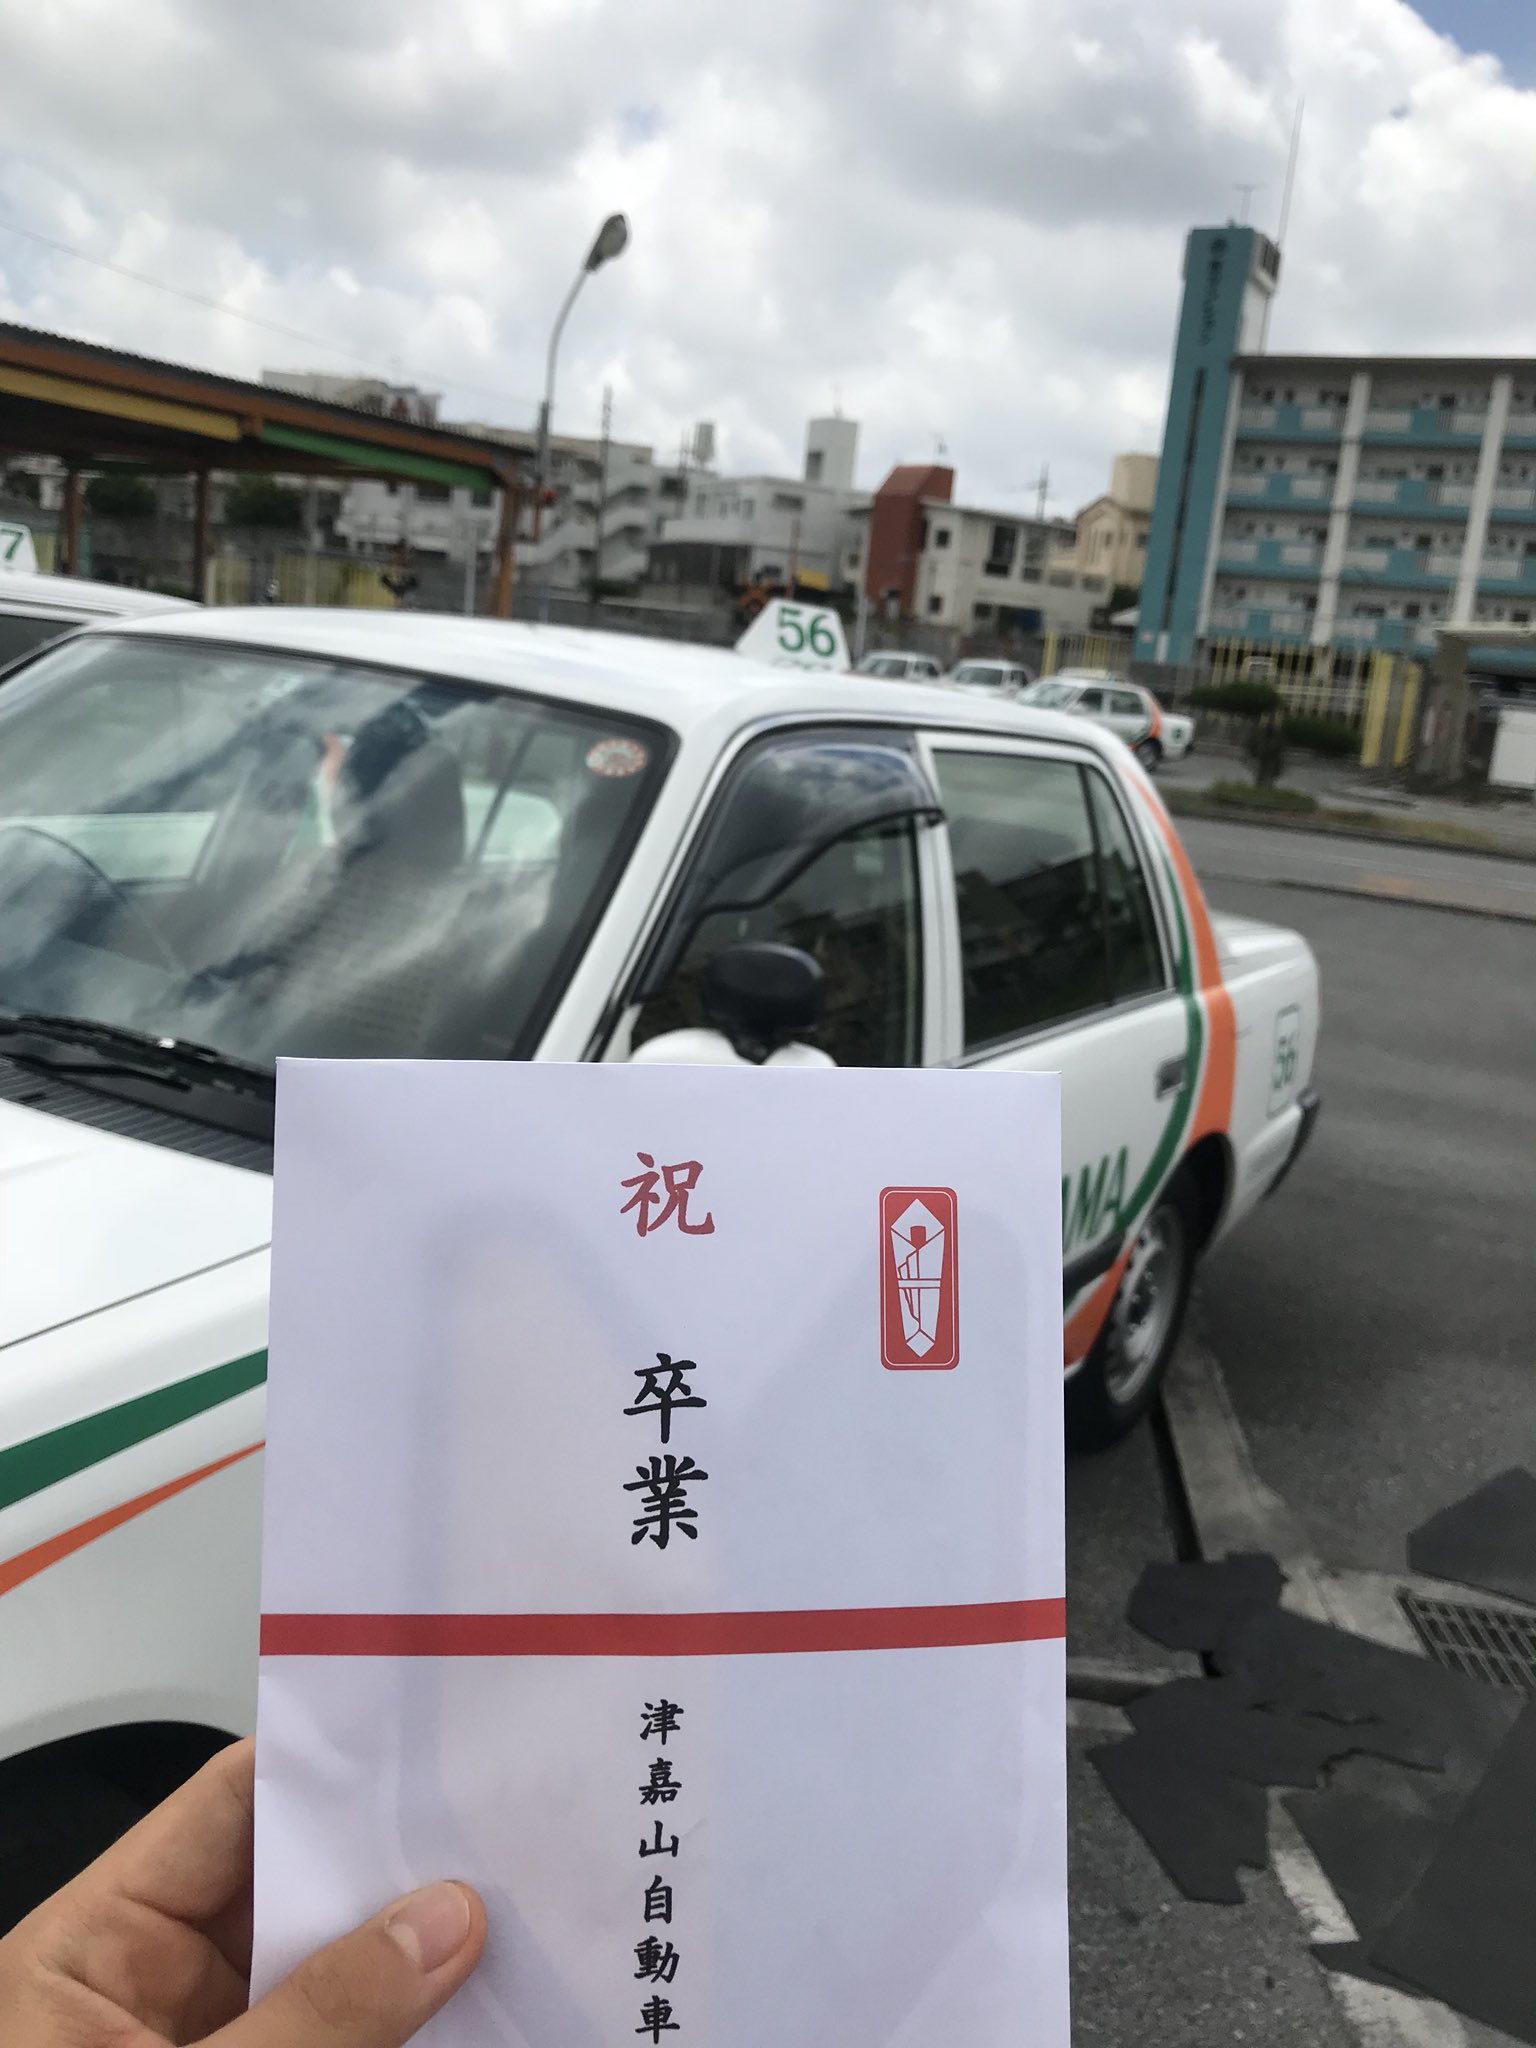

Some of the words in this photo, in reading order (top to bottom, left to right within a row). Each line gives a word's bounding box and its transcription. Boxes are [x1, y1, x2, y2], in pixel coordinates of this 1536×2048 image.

[778, 606, 836, 657] 56
[620, 1152, 715, 1237] 祝
[623, 1353, 708, 1549] 卒業
[633, 1699, 685, 2044] 津嘉山自動車
